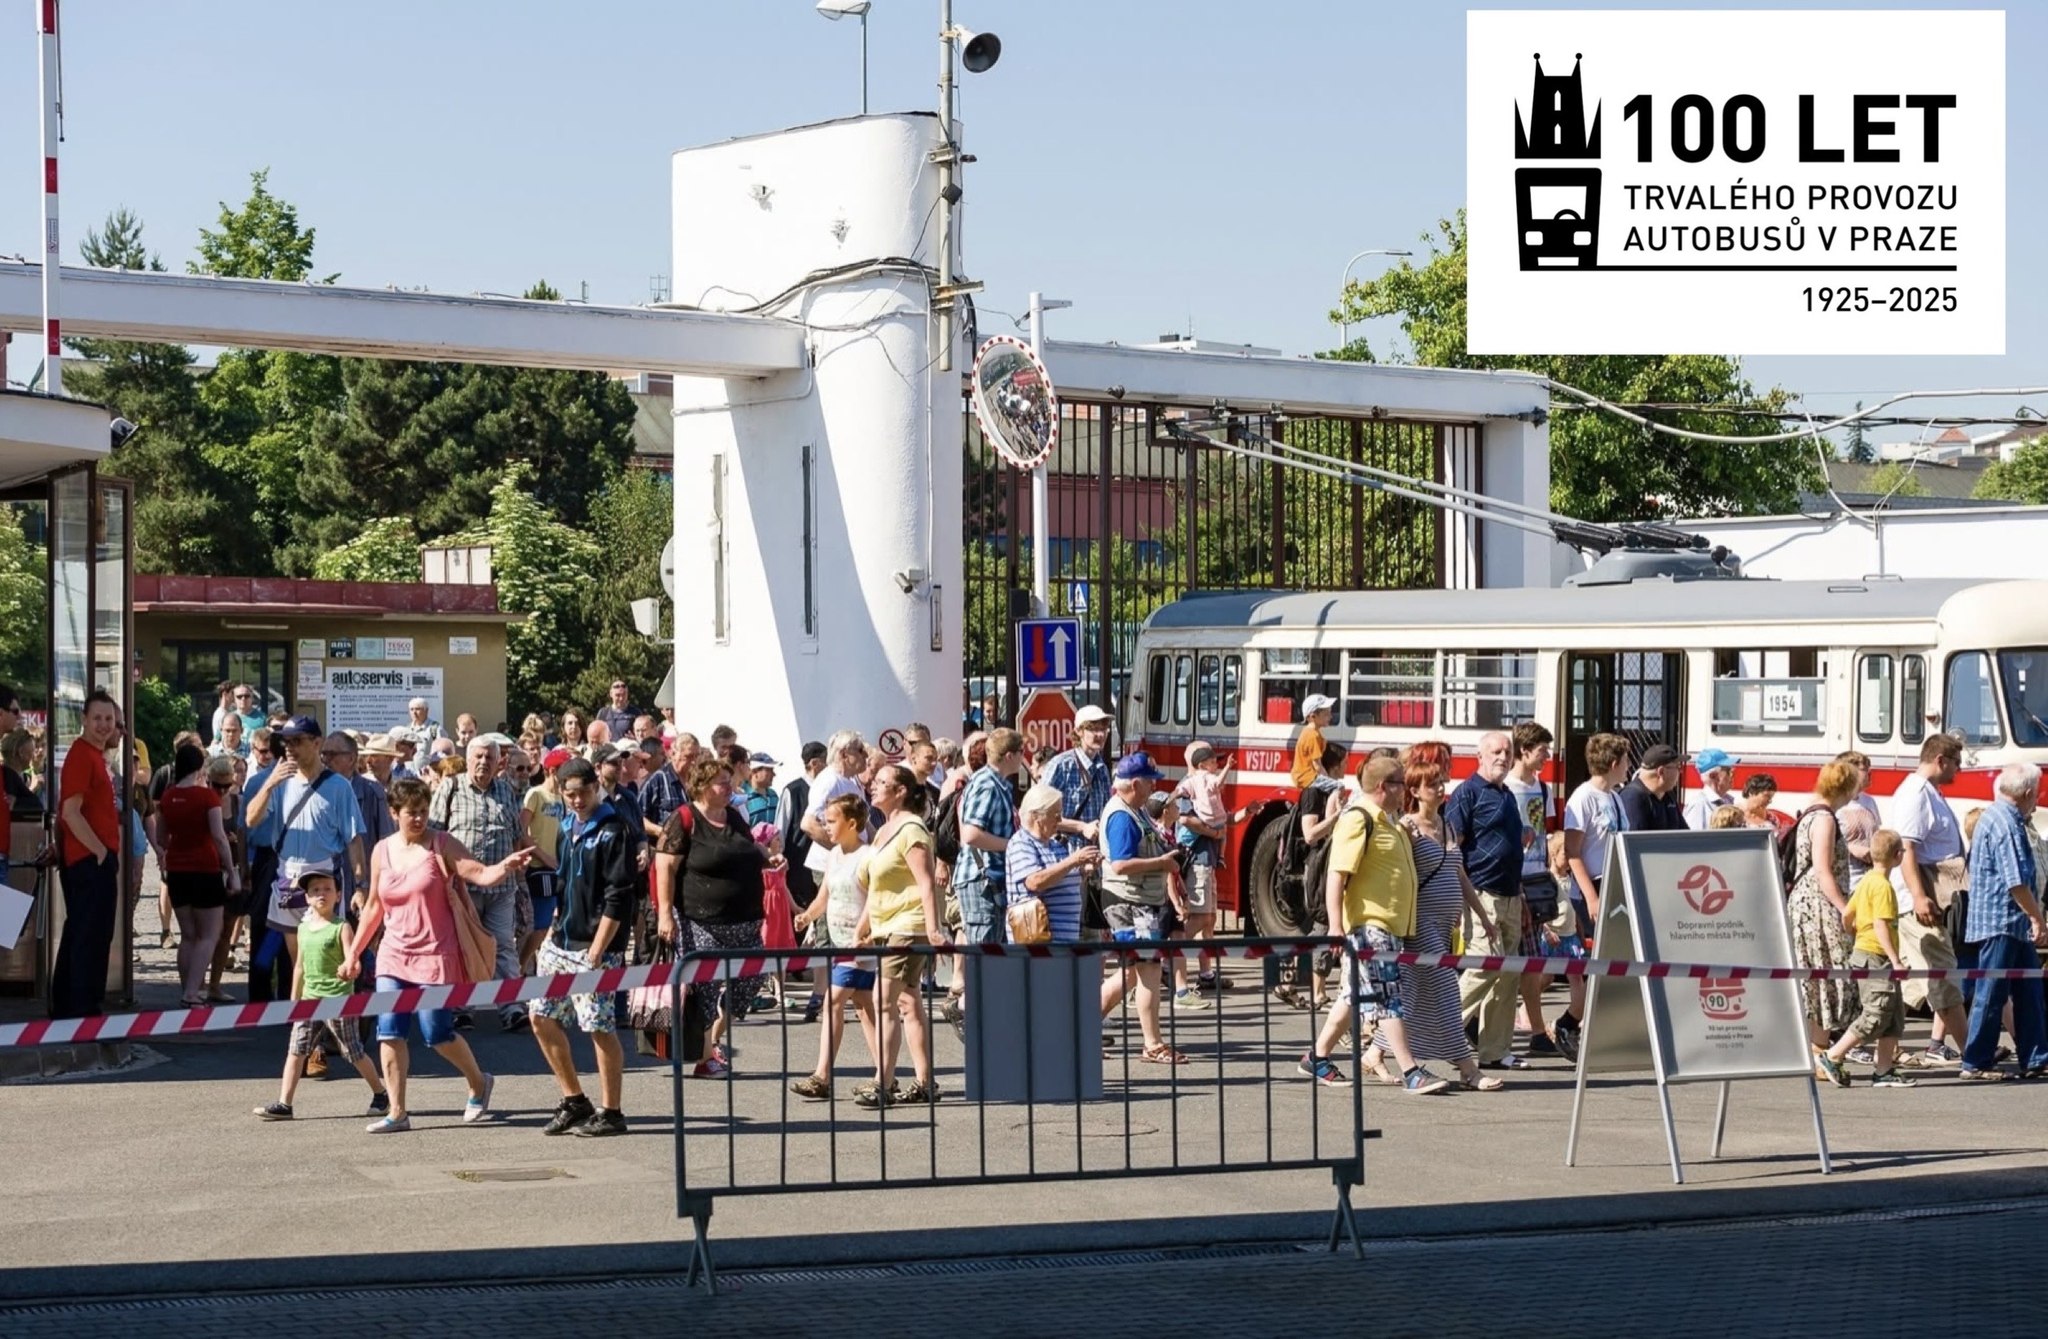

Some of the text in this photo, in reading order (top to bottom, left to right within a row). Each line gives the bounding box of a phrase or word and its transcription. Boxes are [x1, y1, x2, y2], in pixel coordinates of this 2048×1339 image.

[332, 670, 403, 685] autoservis
[1769, 695, 1796, 712] 1954
[1026, 718, 1073, 753] STOP
[1245, 749, 1281, 770] VSTUP
[1677, 919, 1744, 930] Dopravní podnik
[1669, 930, 1755, 941] hlavního města Prahy
[1708, 995, 1725, 1007] 90
